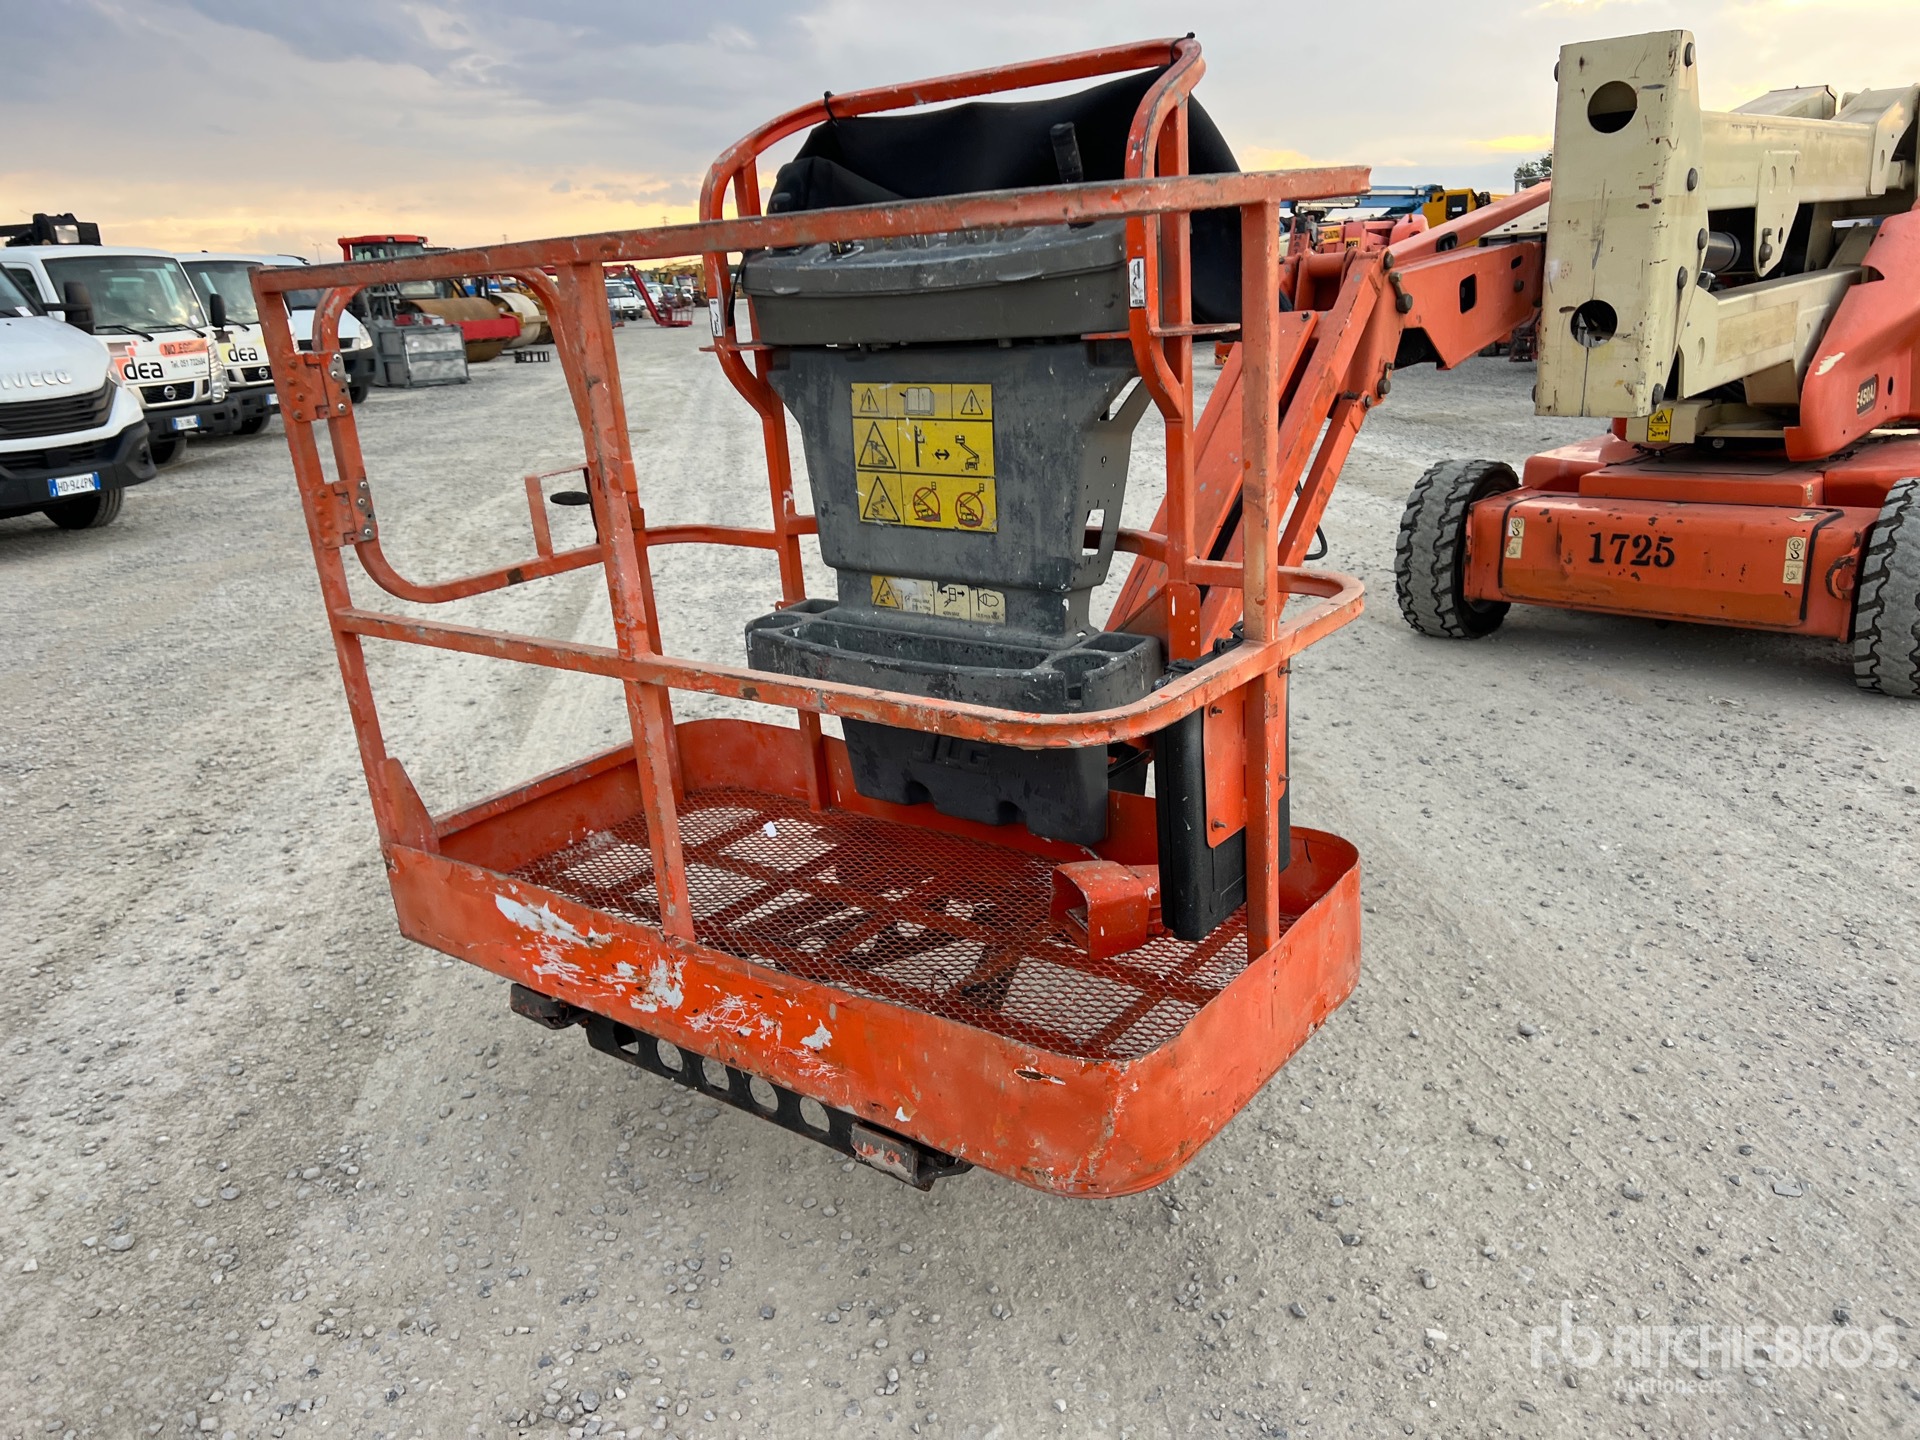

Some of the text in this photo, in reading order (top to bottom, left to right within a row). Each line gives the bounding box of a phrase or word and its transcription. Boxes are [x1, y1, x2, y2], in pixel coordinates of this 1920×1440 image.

[228, 344, 258, 362] dea
[0, 369, 72, 390] IVECO
[124, 357, 163, 380] dea
[1588, 532, 1675, 568] 1725
